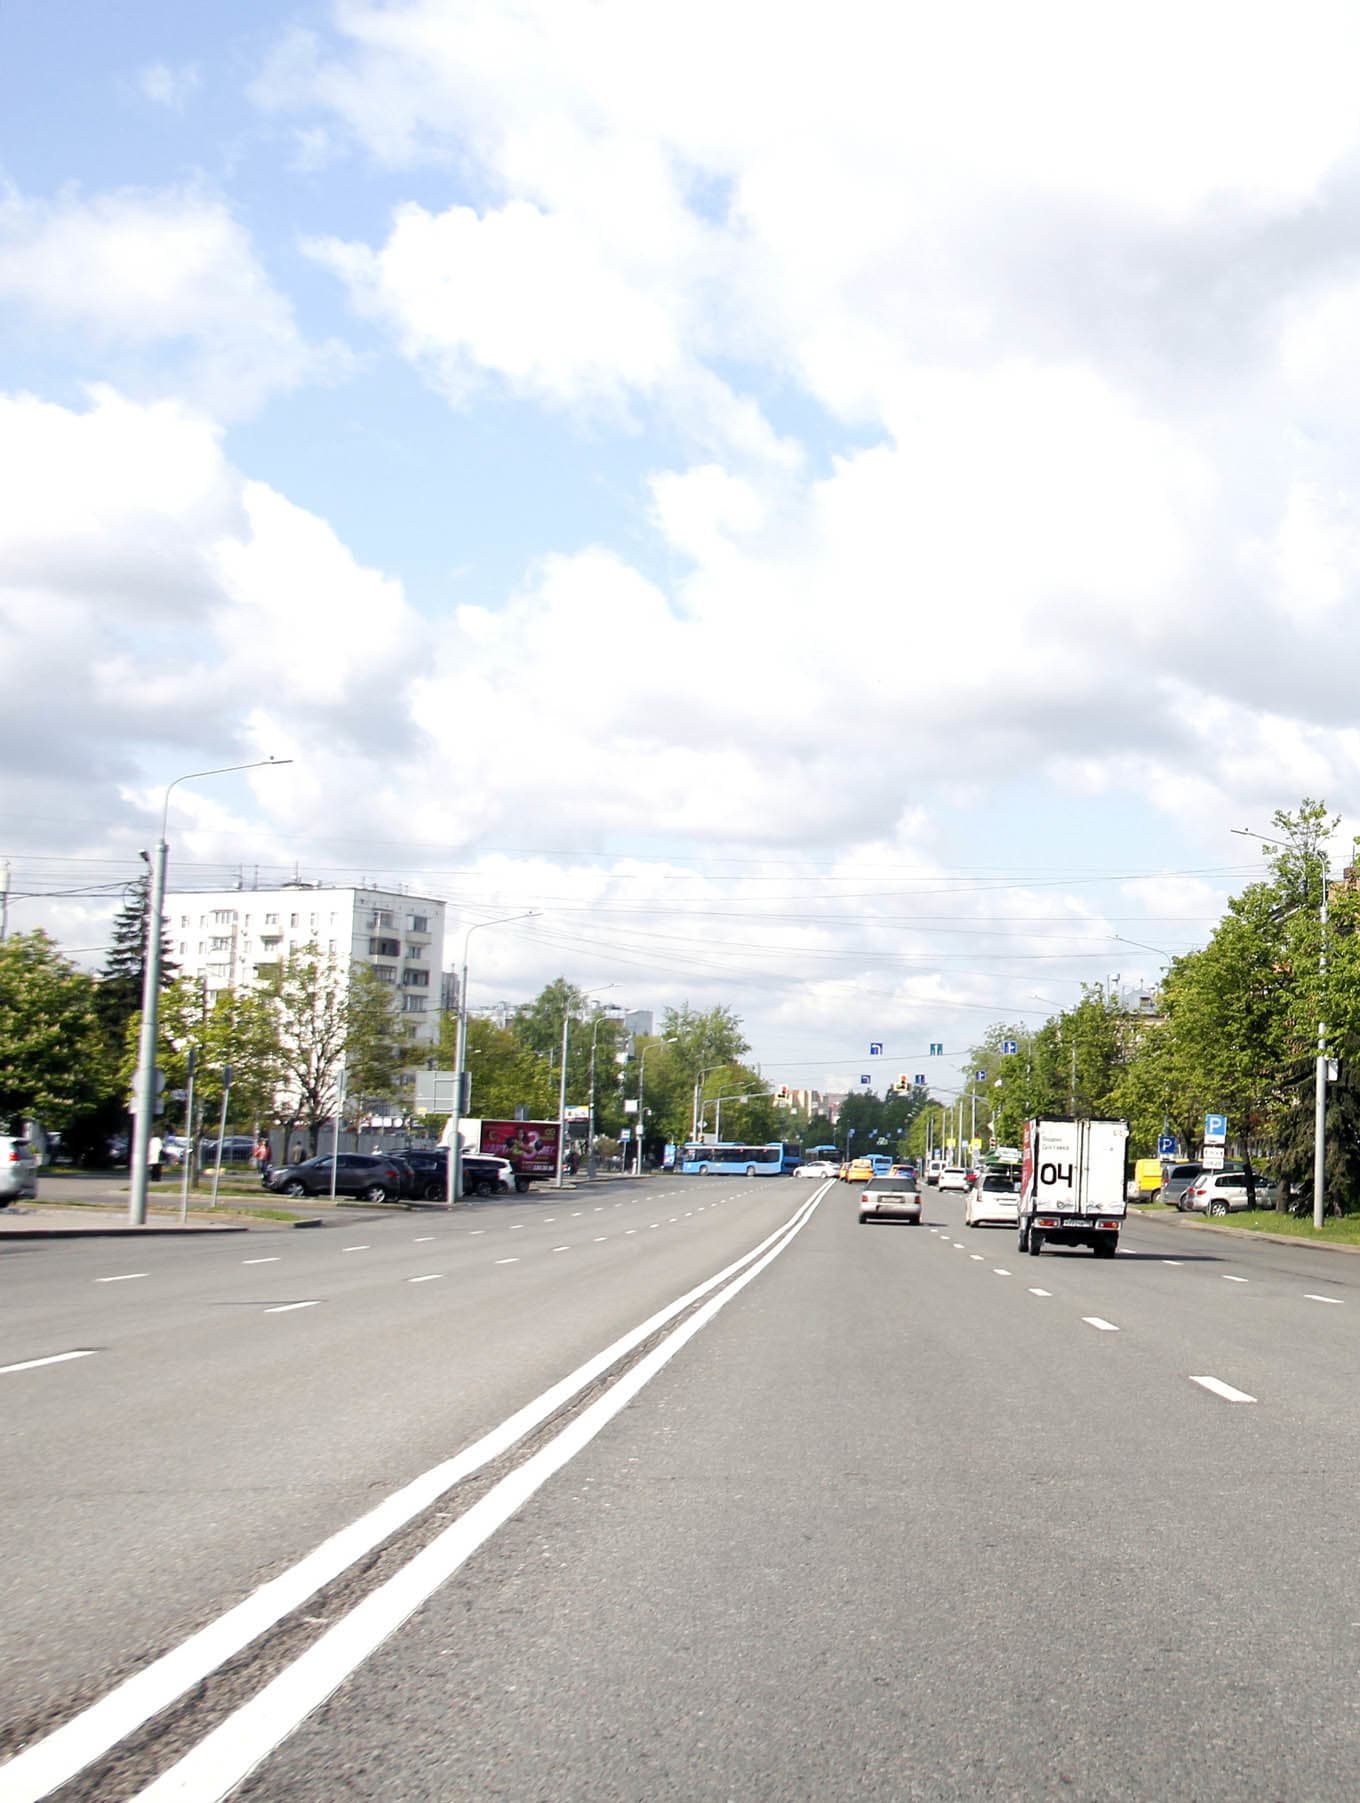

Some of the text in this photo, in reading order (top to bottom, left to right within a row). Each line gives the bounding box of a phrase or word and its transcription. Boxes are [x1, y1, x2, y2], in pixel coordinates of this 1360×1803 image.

[1209, 1118, 1222, 1133] P
[1162, 1139, 1173, 1151] P
[1040, 1163, 1073, 1188] 04
